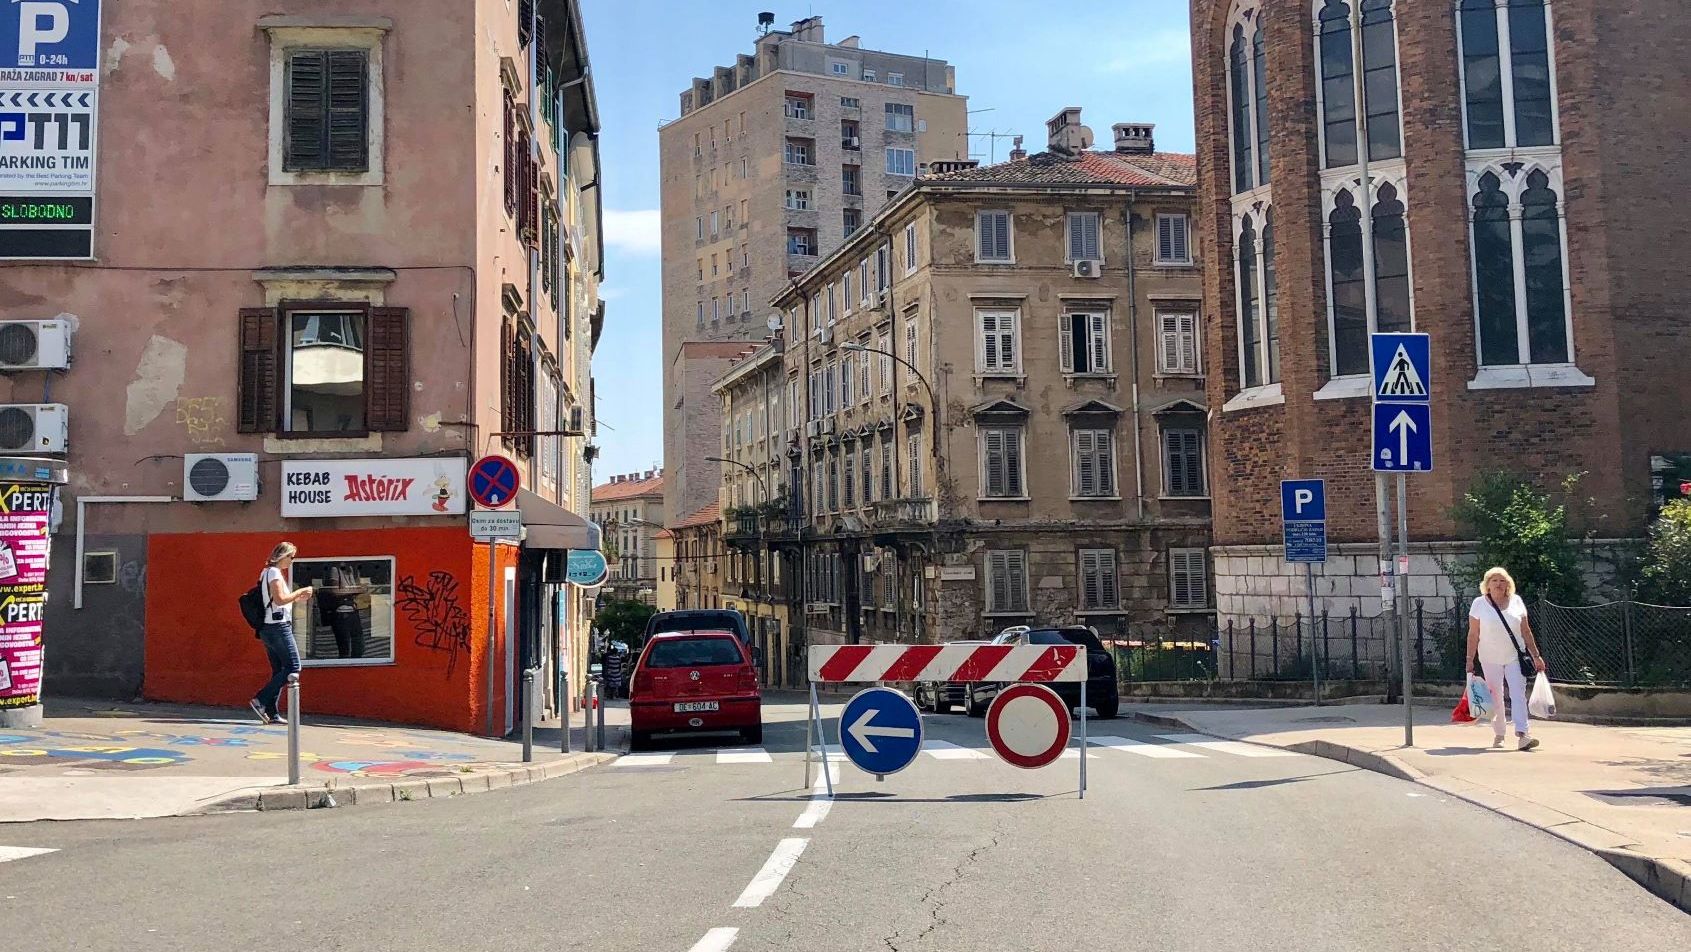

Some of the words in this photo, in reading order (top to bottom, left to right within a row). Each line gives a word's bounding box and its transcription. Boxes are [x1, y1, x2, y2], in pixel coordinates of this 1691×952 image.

[19, 2, 70, 55] P
[40, 54, 68, 65] 0-24h
[24, 71, 57, 82] ZAGRAD
[59, 71, 65, 82] 7
[61, 155, 88, 169] TIM
[2, 204, 74, 218] SLOBODNO
[287, 472, 331, 486] KEBAB
[344, 474, 415, 502] Astérix
[289, 490, 332, 504] HOUSE
[1295, 489, 1313, 514] P
